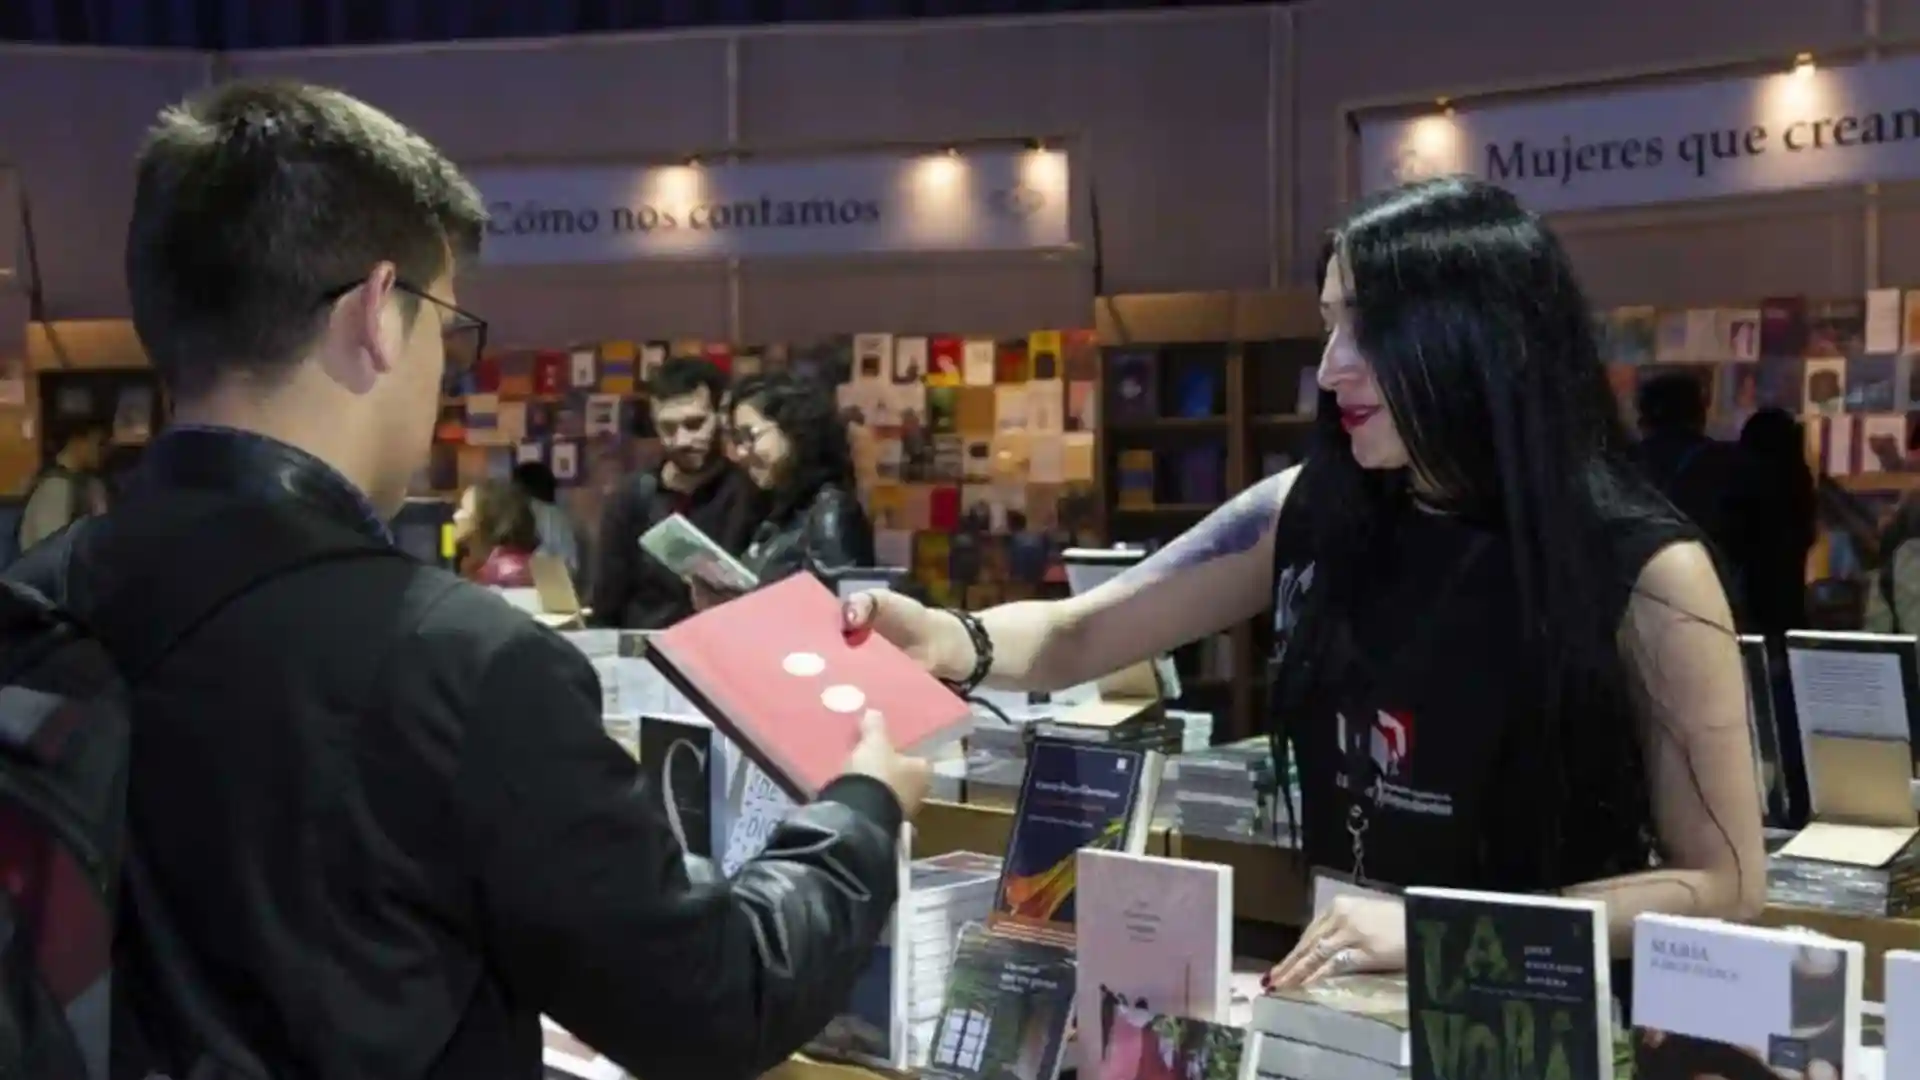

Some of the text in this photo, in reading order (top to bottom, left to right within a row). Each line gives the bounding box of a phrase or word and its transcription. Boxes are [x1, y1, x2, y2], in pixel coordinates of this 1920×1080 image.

[1485, 107, 1920, 184] Mujeres que crean
[485, 195, 881, 236] Cómo nos contamos
